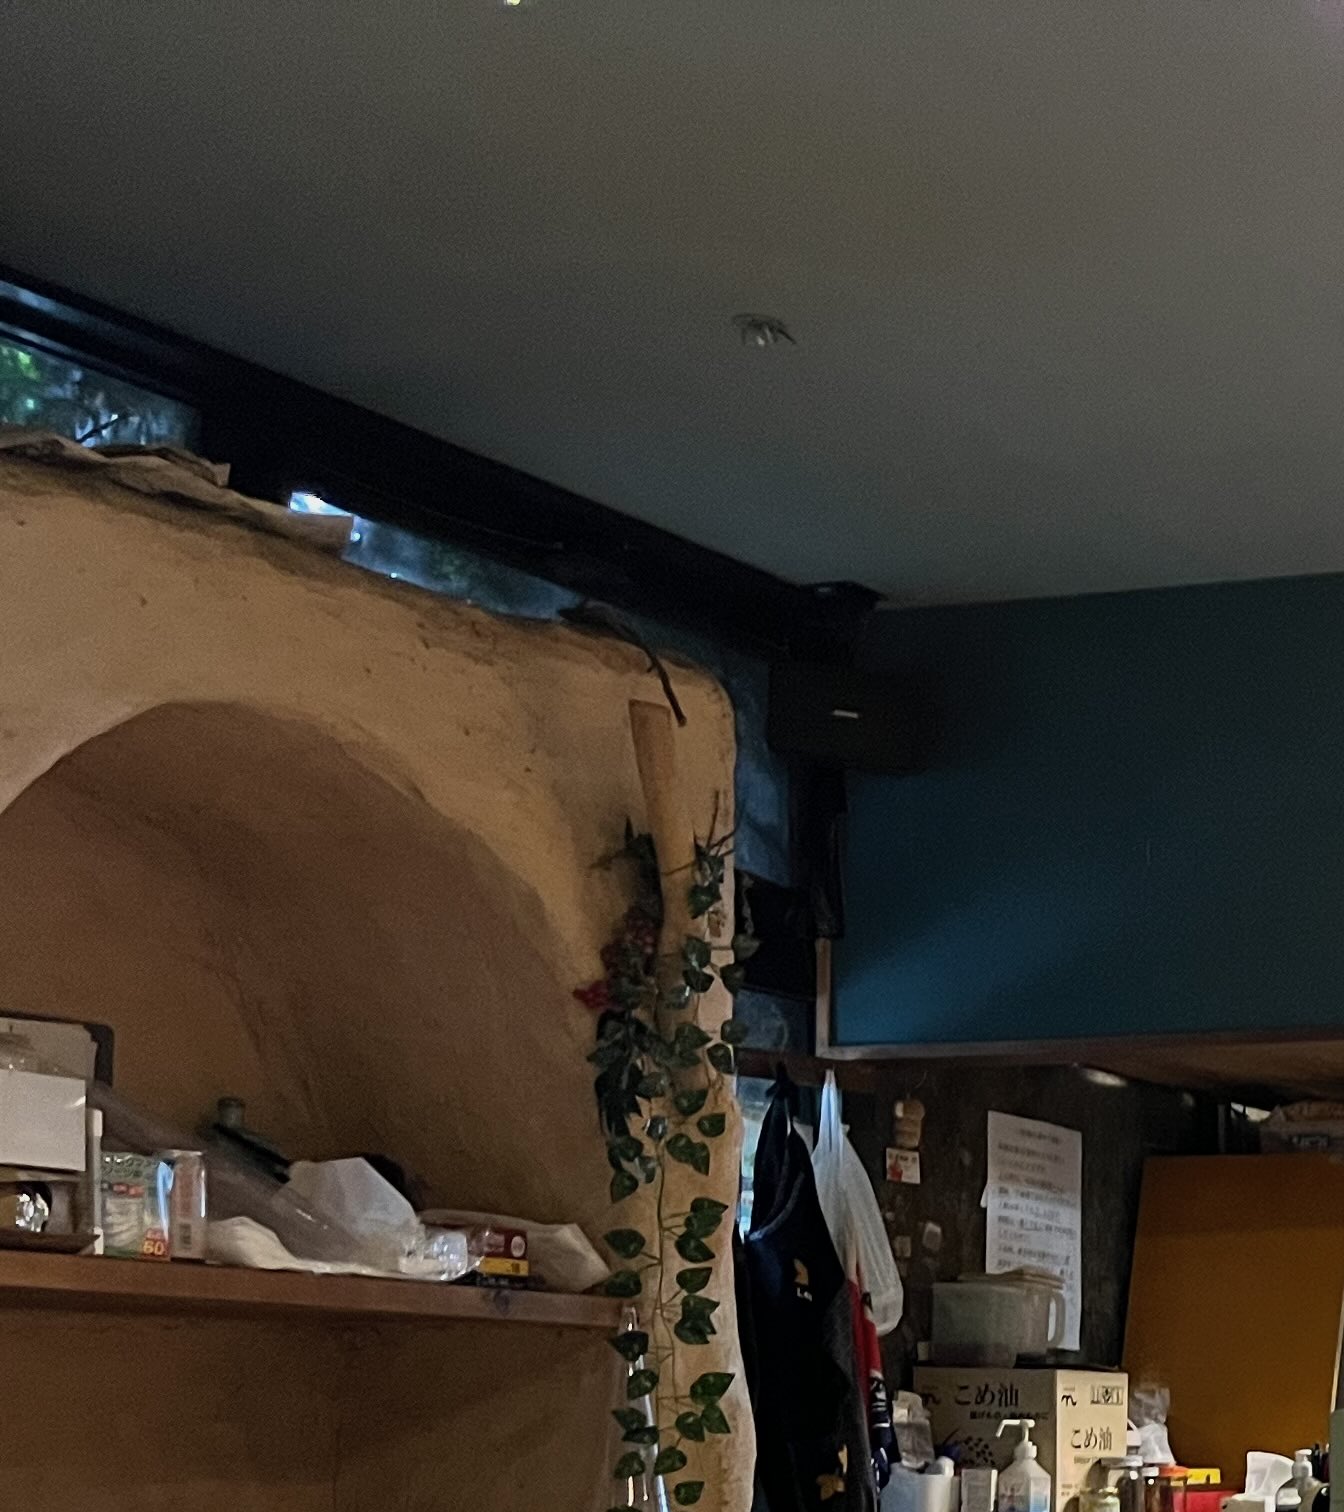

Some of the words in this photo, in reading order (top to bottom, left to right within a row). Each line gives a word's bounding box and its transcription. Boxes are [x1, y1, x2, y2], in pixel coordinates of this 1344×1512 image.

[956, 1382, 1020, 1408] こめ油
[1070, 1426, 1114, 1451] こめ油
